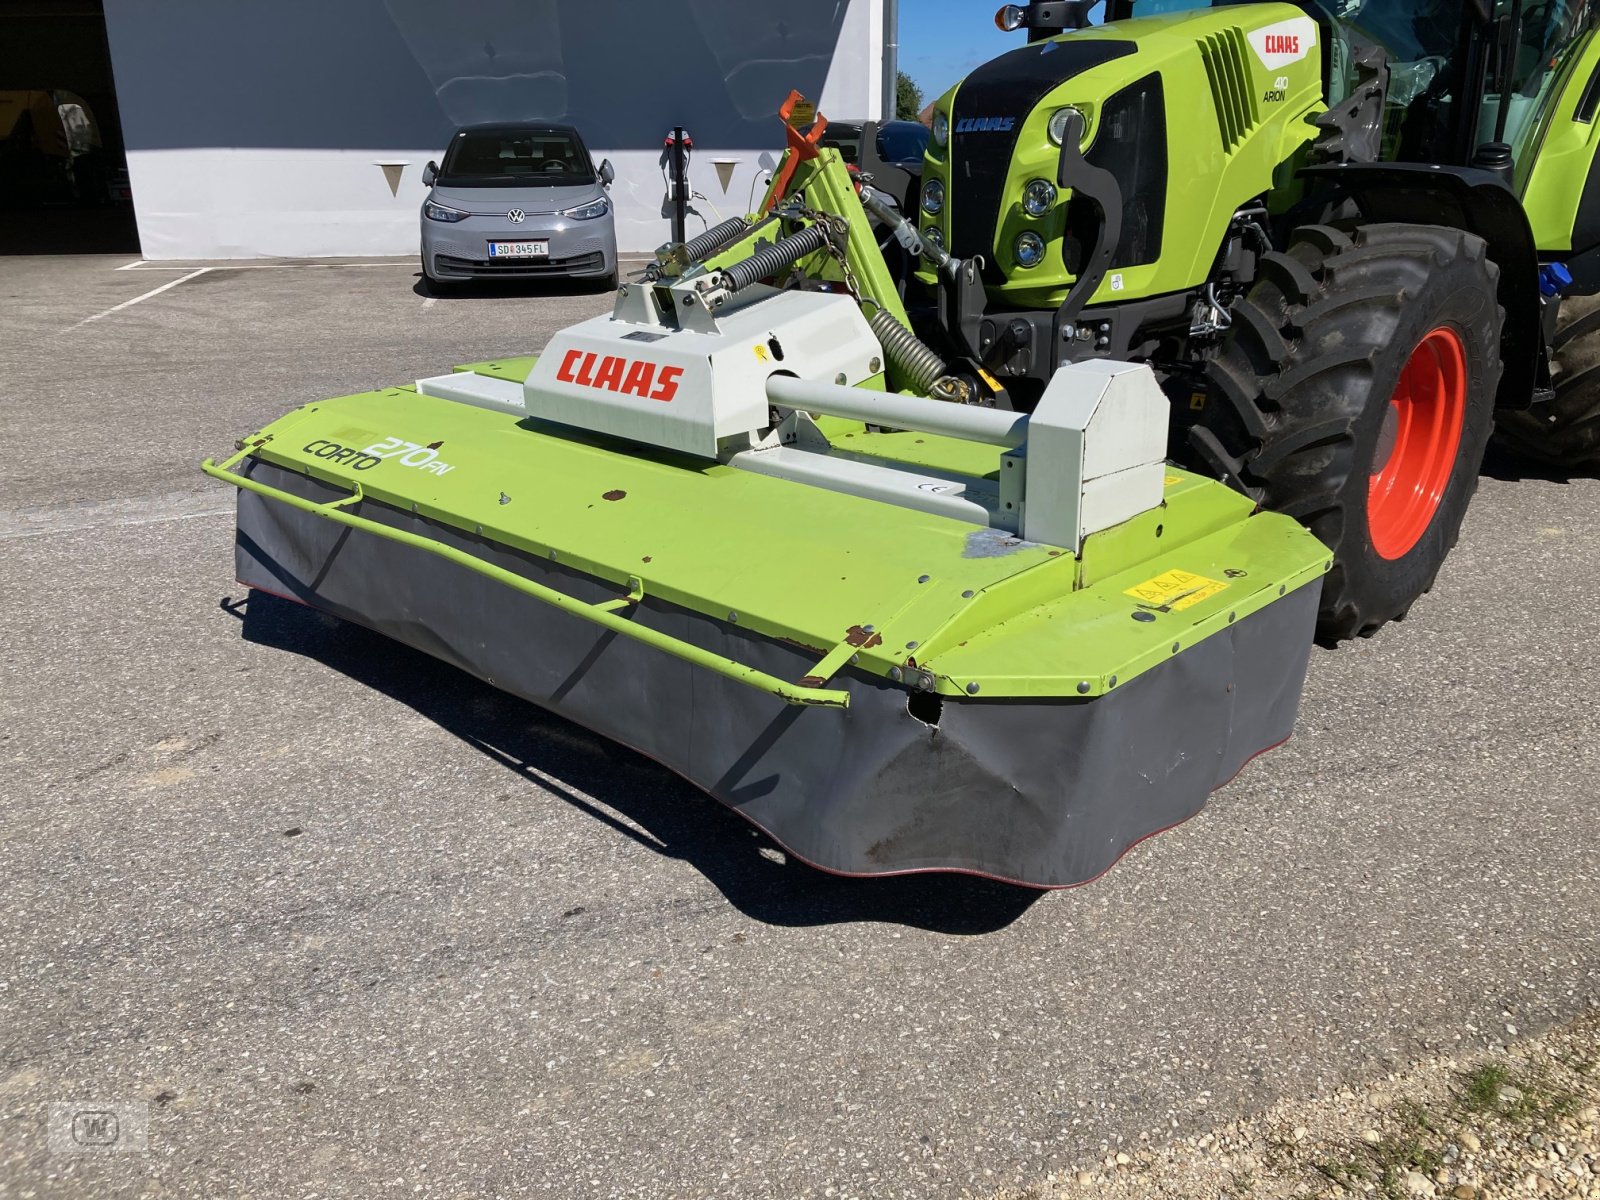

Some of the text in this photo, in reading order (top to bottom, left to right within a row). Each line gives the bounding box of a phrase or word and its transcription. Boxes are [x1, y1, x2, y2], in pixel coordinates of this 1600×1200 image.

[1265, 35, 1299, 54] CLAAS
[1274, 76, 1289, 90] 410
[1263, 90, 1286, 103] ARION
[955, 116, 1015, 133] CLAAS
[556, 349, 685, 402] CLAAS
[302, 439, 382, 471] CORTO
